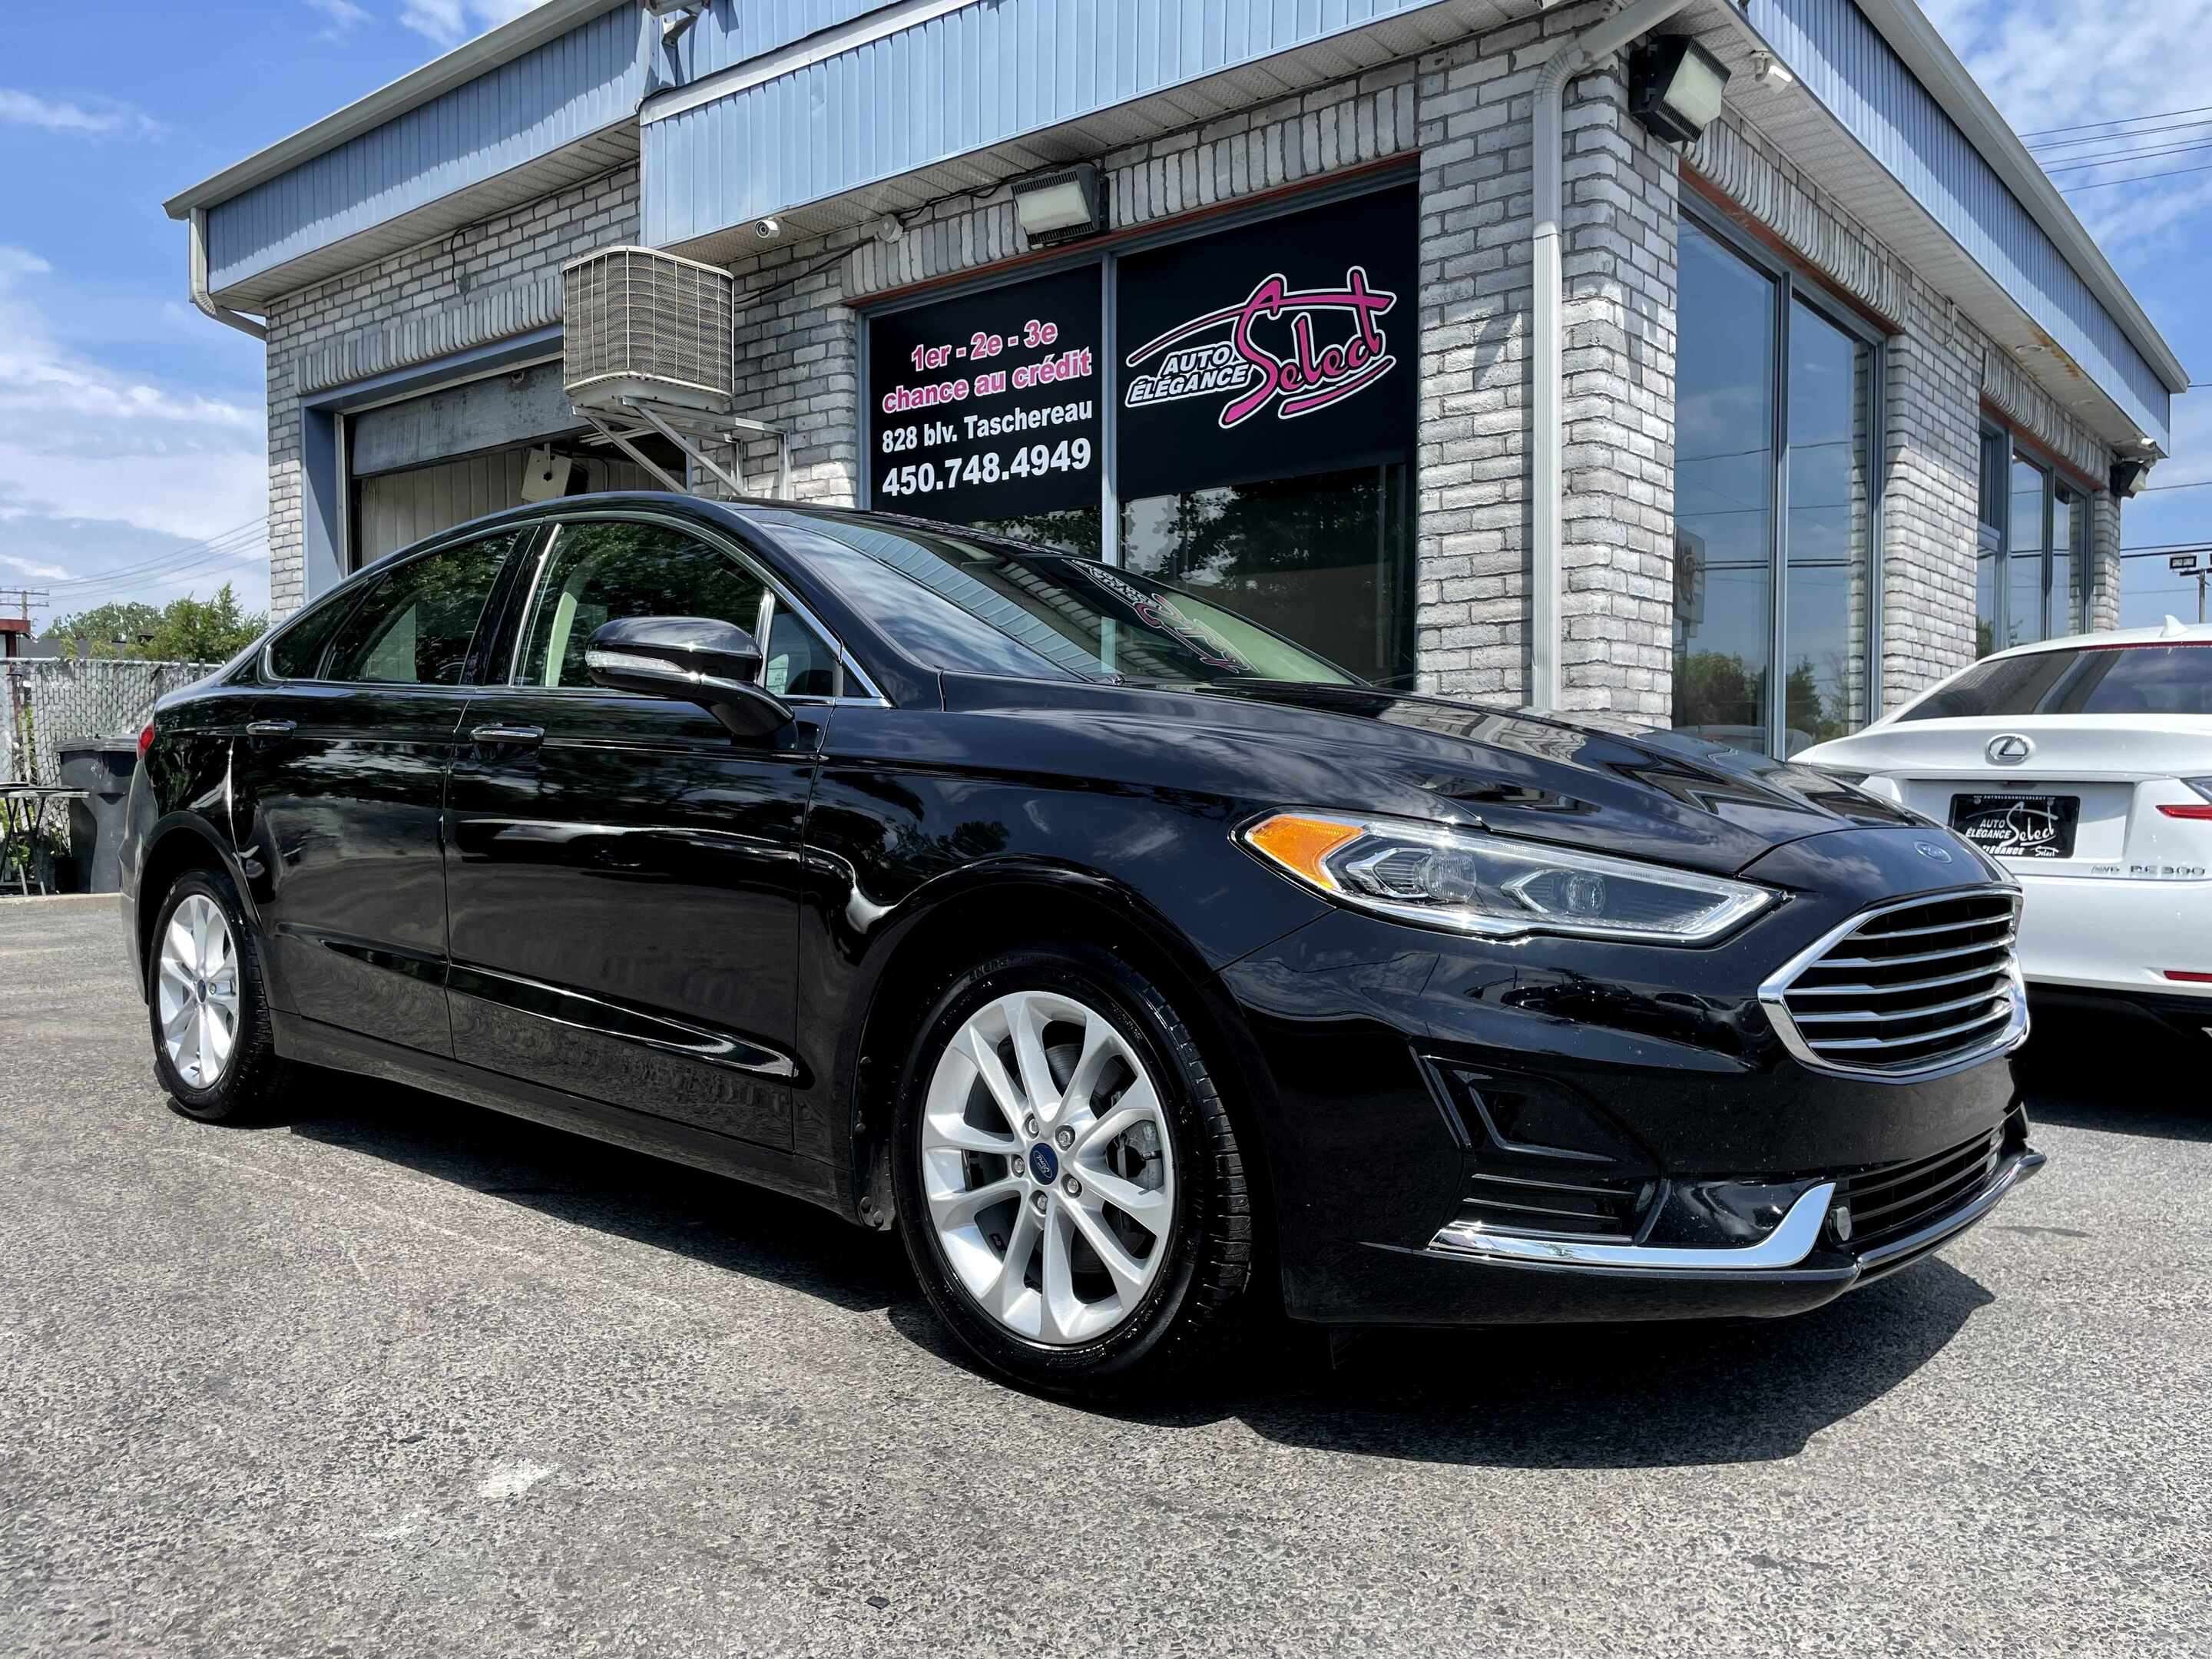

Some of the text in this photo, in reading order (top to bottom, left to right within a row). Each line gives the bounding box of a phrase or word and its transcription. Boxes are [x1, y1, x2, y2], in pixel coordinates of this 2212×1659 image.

[911, 344, 952, 372] 1er
[970, 332, 1003, 360] 2e
[1024, 320, 1058, 348] 3e
[1161, 346, 1230, 376] AUTO
[1220, 266, 1395, 427] Select
[882, 346, 1093, 413] chance au crédit
[1129, 364, 1250, 404] ÉLÉGANCE
[882, 400, 1093, 453] 828 blv. Taschereau
[882, 438, 1091, 497] 450.748.4949
[1965, 826, 2012, 839] ÉLÉGANCE
[1979, 818, 2006, 829] AUTO
